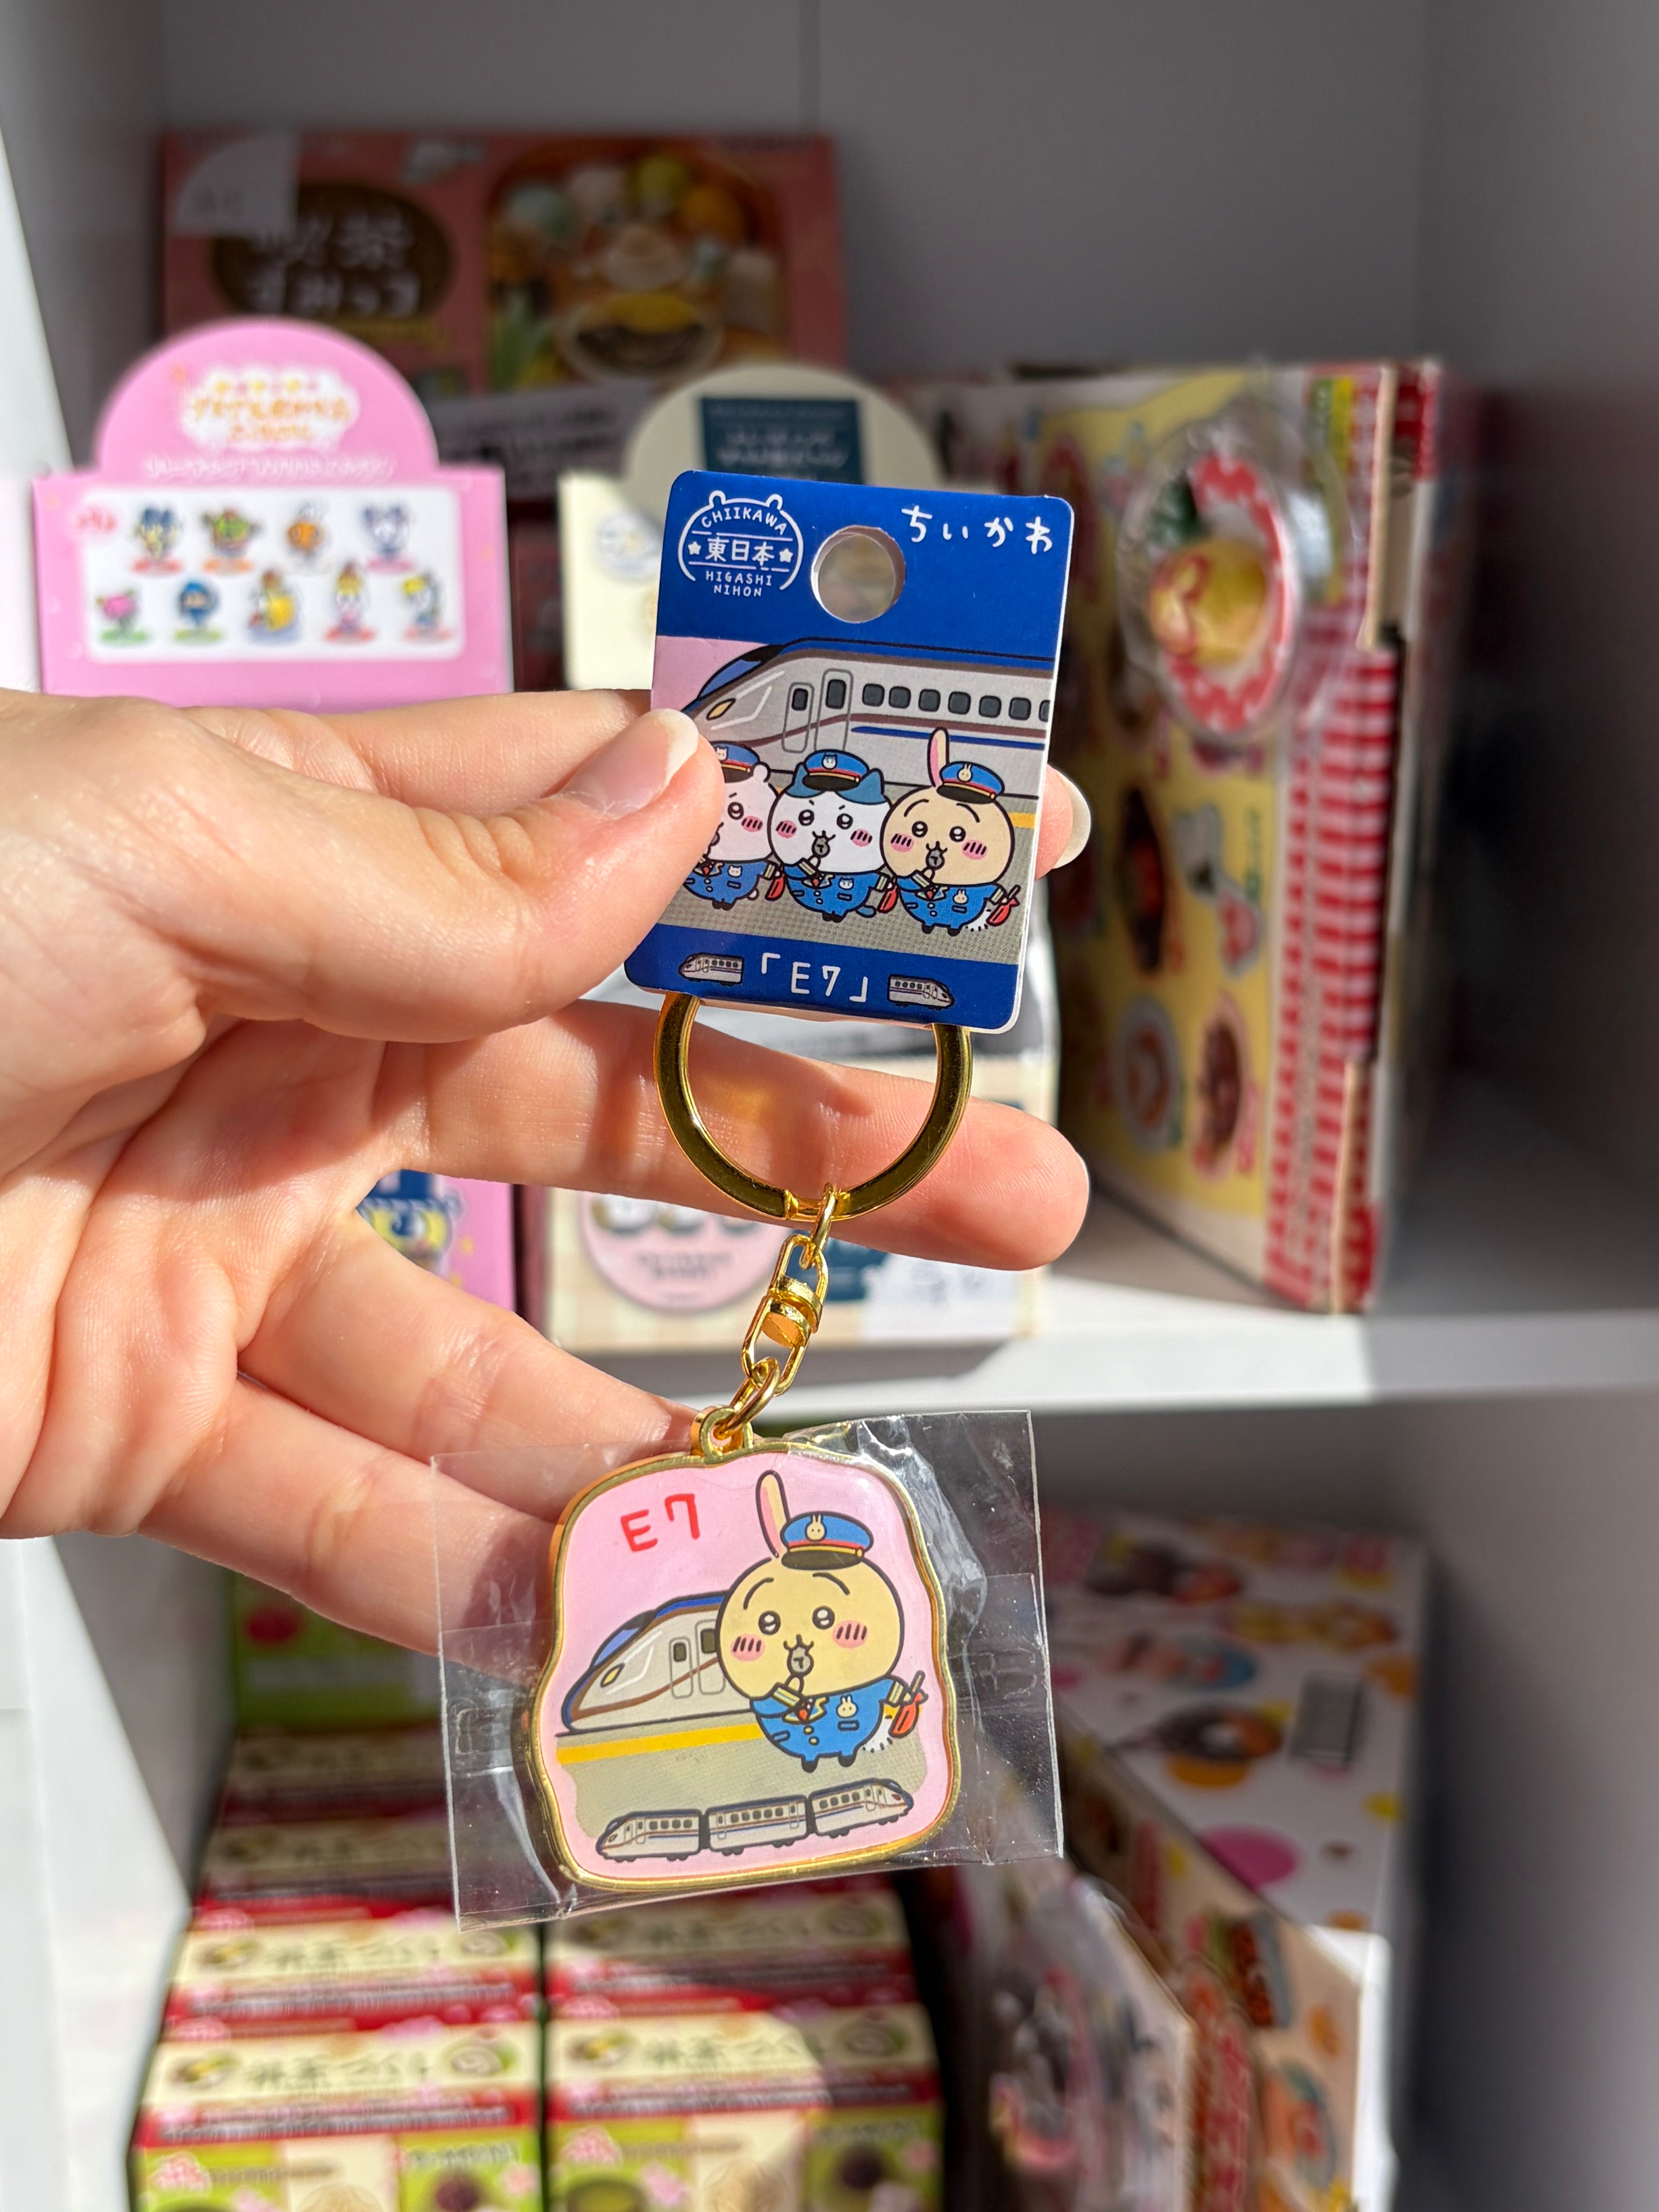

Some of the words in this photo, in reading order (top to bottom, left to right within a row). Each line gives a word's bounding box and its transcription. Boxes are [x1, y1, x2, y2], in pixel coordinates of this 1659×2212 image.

[701, 506, 787, 535] CHIIKAWA
[901, 505, 1053, 555] ちいかわ
[705, 536, 775, 566] 東日本
[706, 570, 772, 586] HIGASHI
[713, 584, 762, 597] NIHON
[620, 1492, 701, 1553] E7
